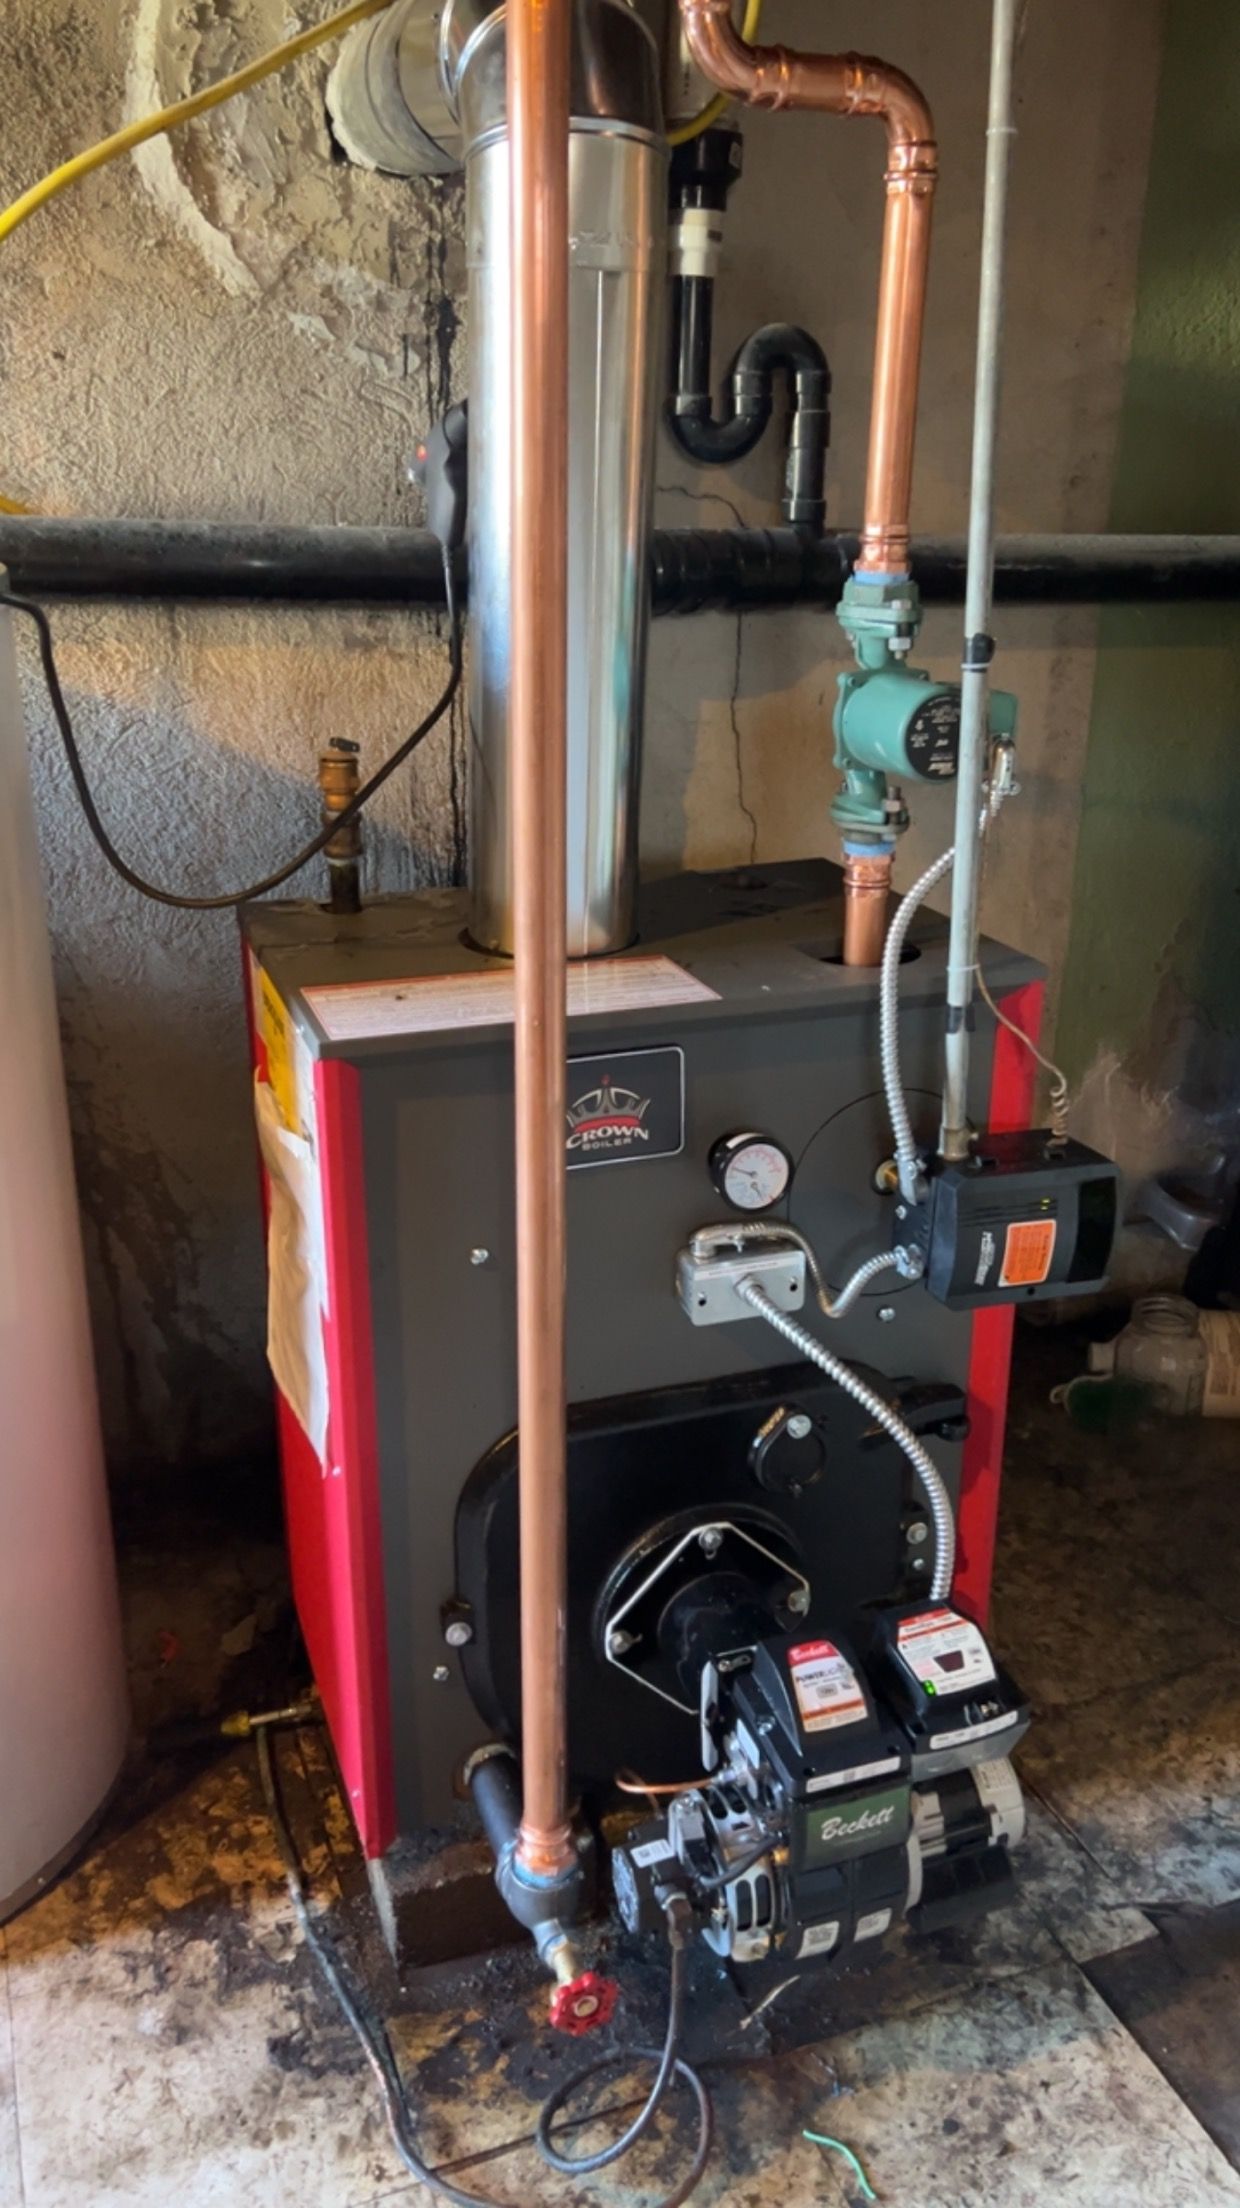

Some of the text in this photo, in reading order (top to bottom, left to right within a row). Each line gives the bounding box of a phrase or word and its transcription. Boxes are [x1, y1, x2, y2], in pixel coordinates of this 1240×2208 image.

[566, 1126, 649, 1150] CROWN
[581, 1137, 633, 1152] BOILER
[821, 1805, 895, 1841] Beckett
